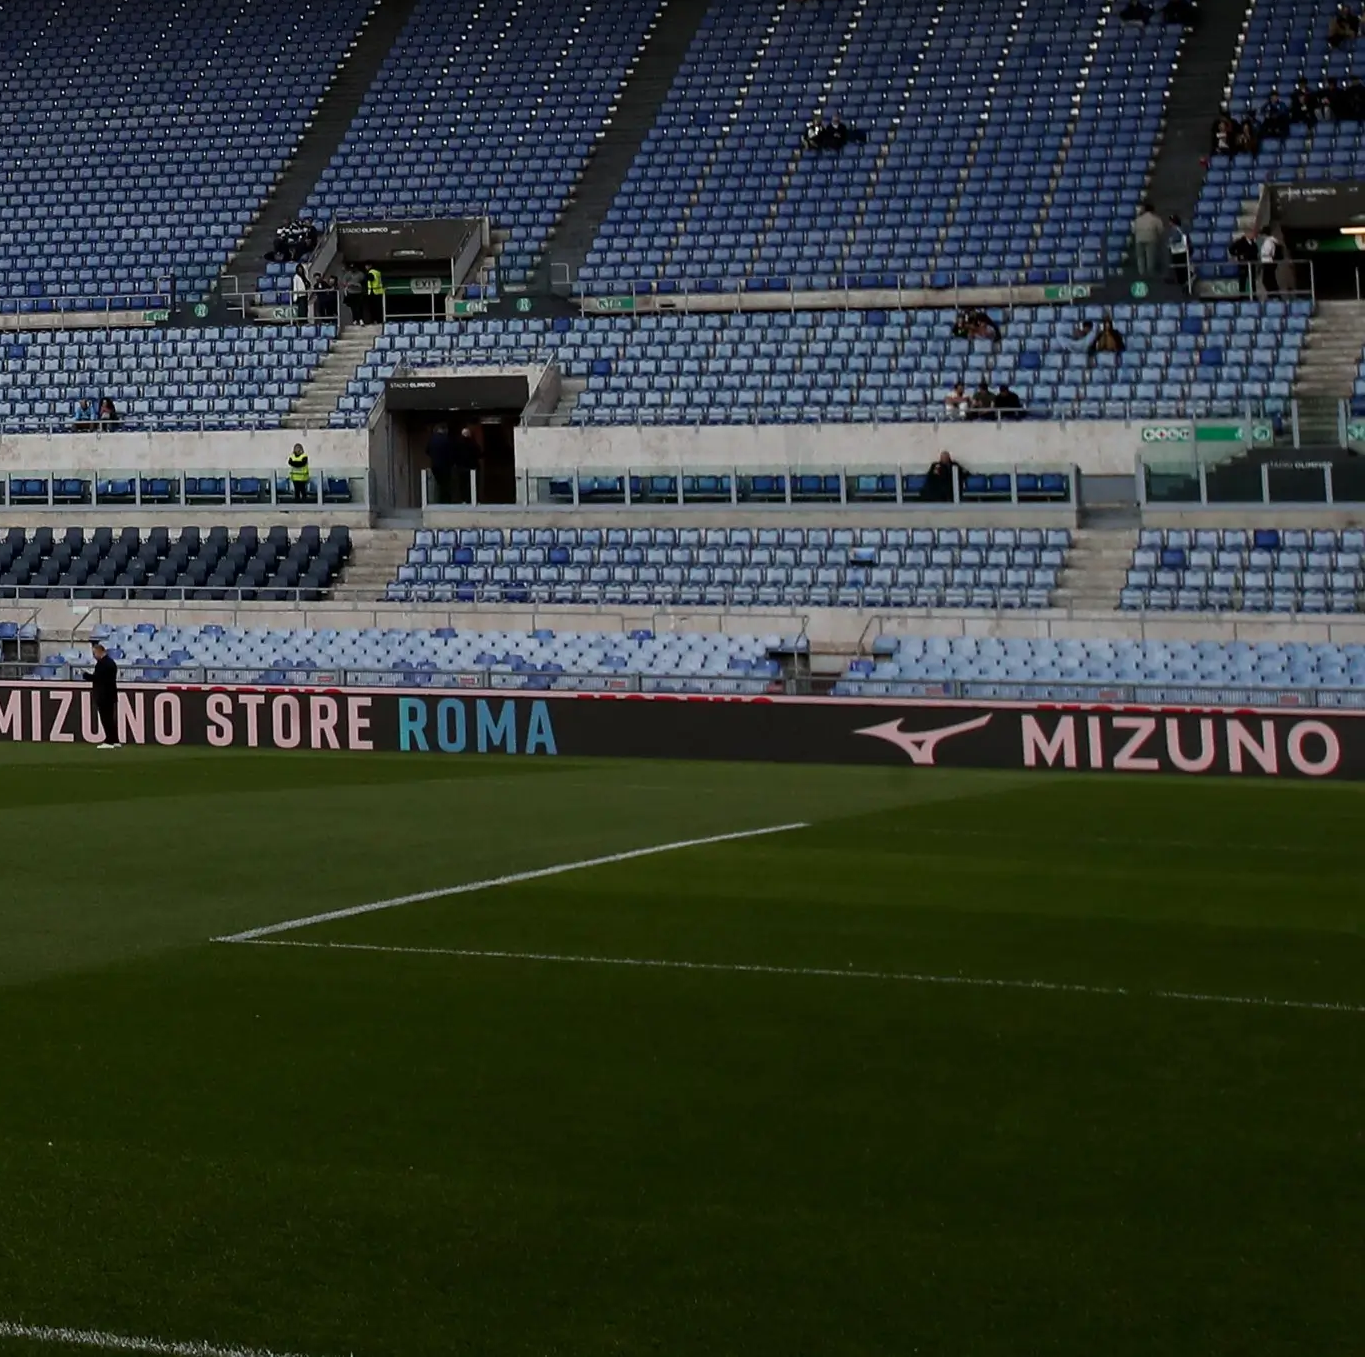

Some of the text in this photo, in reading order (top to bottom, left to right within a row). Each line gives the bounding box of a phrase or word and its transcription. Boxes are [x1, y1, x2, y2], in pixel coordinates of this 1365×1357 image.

[207, 693, 374, 750] STORE
[398, 697, 558, 755] ROMA
[1021, 714, 1341, 776] MIZUNO
